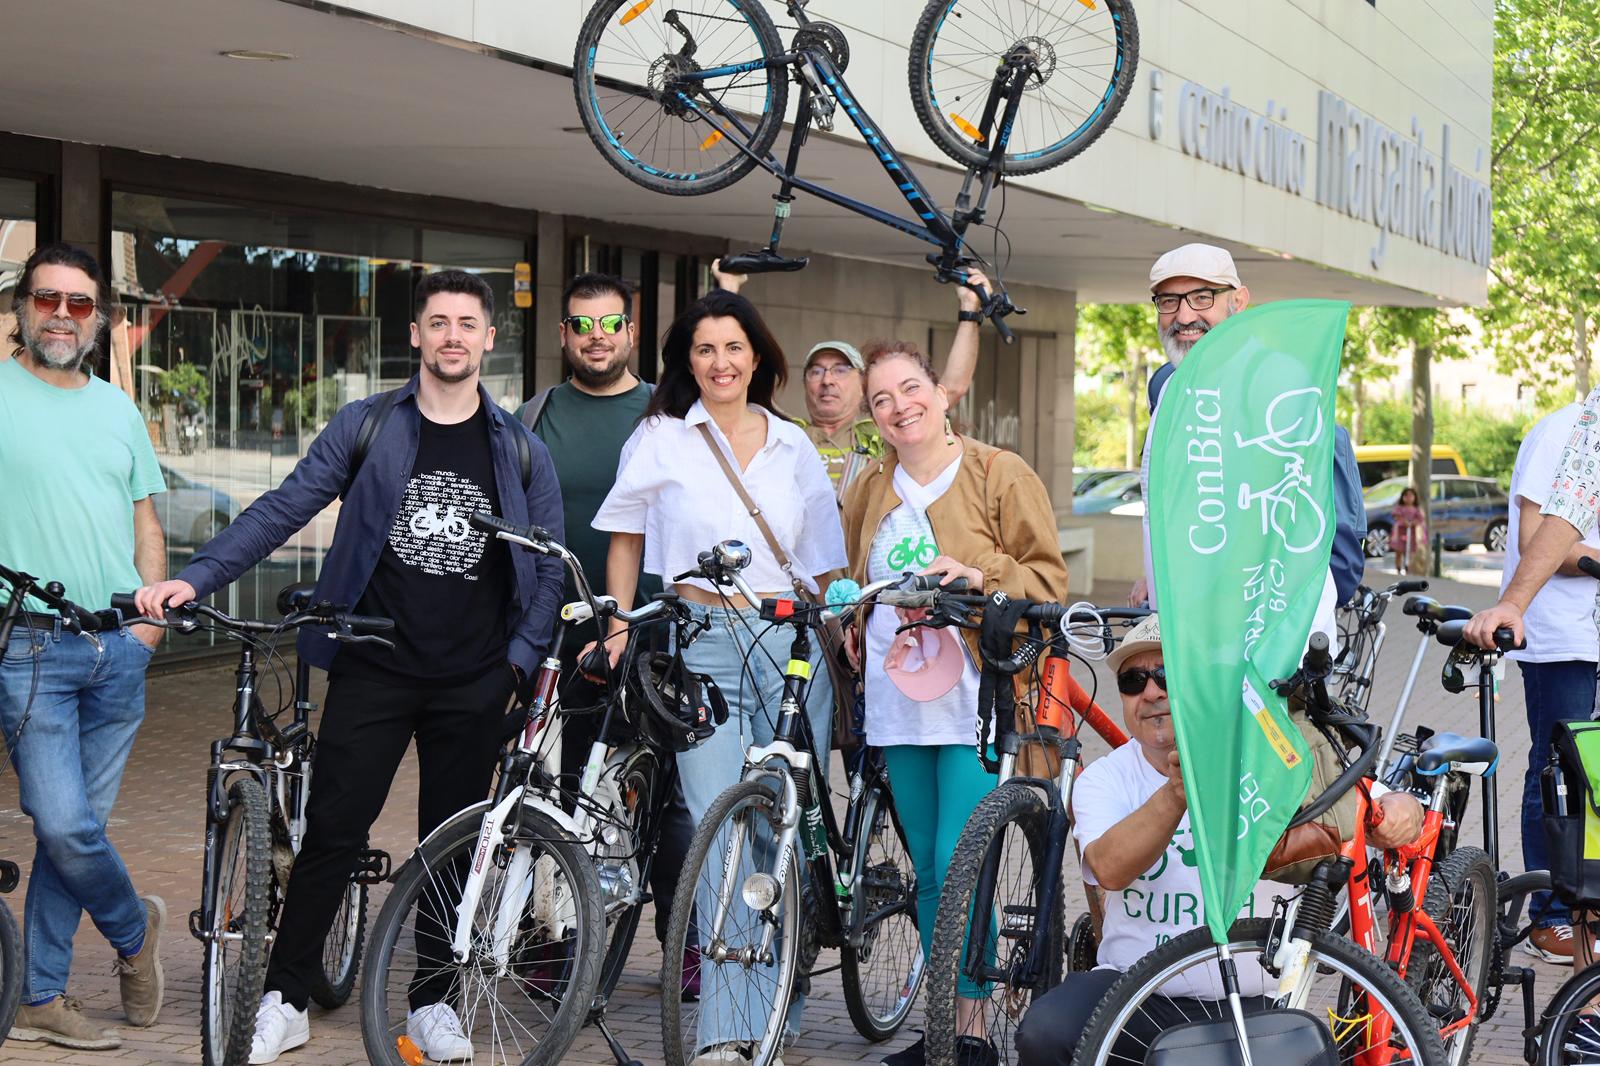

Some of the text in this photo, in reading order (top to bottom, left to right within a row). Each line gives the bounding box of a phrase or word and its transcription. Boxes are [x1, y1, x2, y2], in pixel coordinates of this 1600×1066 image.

[1315, 89, 1435, 270] margarita
[421, 473, 441, 481] bosque
[1186, 385, 1227, 554] ConBici
[422, 490, 447, 498] cadencia
[420, 550, 446, 559] albahaca
[420, 561, 442, 570] frontera
[1242, 562, 1265, 601] EN
[481, 818, 495, 851] T210
